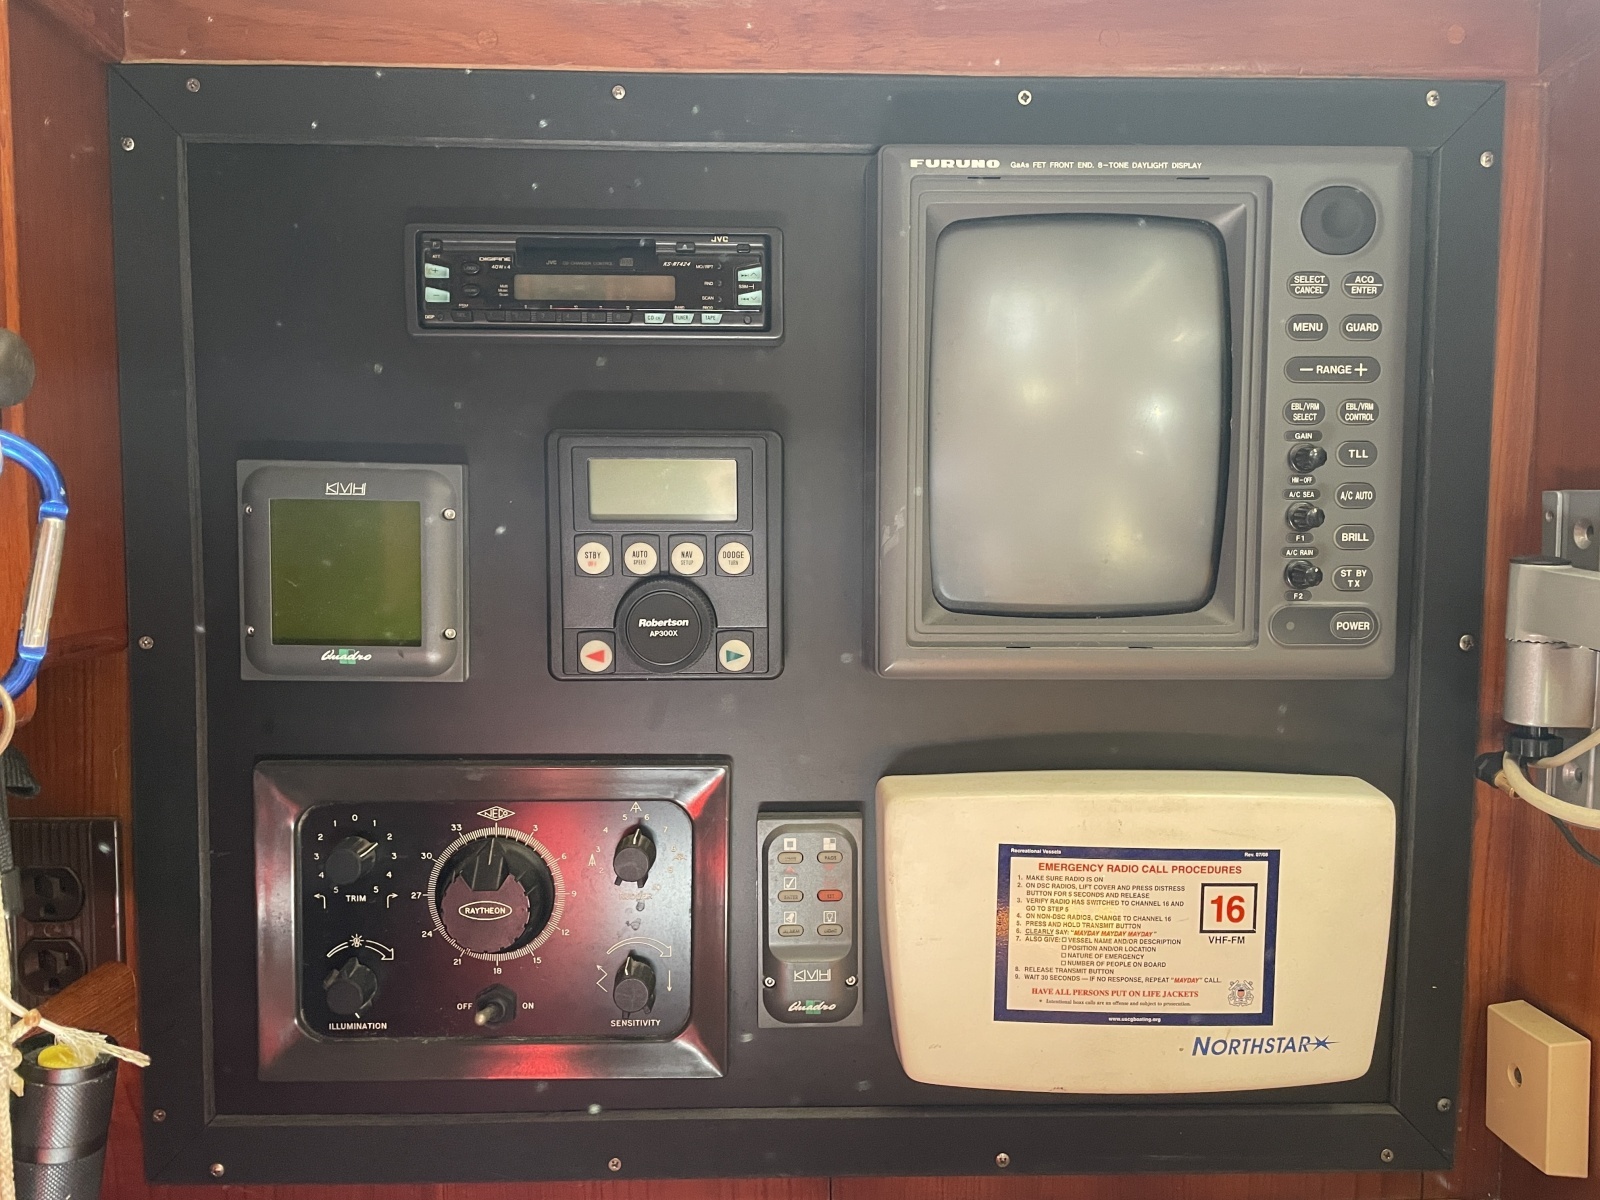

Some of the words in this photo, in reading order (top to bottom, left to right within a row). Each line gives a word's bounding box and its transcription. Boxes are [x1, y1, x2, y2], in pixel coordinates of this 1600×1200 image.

[910, 159, 1000, 168] FURUNO
[1132, 162, 1168, 170] DAYLIGHT
[1294, 275, 1325, 284] SELECT
[1354, 276, 1375, 284] ACQ
[1293, 322, 1323, 332] MENU
[1345, 323, 1379, 332] GUARD
[1316, 365, 1352, 374] RANGE
[1291, 402, 1320, 411] EBL/VRM
[1345, 402, 1374, 412] EBL/VRM
[1345, 413, 1374, 421] CONTROL
[1348, 449, 1369, 458] TLL
[325, 482, 366, 496] KVH
[1340, 491, 1353, 501] A/C
[1355, 491, 1373, 500] AUTO
[1341, 532, 1370, 542] BRILL
[638, 618, 689, 627] Robertson
[1336, 622, 1370, 631] POWER
[321, 649, 372, 661] Quadro
[420, 852, 433, 860] 30
[1038, 862, 1104, 873] EMERGENCY
[1106, 864, 1139, 873] RADIO
[1141, 865, 1168, 874] CALL
[1171, 865, 1242, 874] PROCEDURES
[345, 894, 367, 902] TRIM
[464, 906, 506, 915] RAYTHEON
[1210, 895, 1245, 923] 16
[561, 928, 570, 936] 12
[1208, 936, 1245, 944] VHF-FM
[533, 956, 542, 964] 15
[793, 968, 831, 982] KVH
[788, 1000, 837, 1012] Quadro
[328, 1022, 388, 1030] ILLUMINATION
[610, 1019, 661, 1027] SENSITIVITY
[1192, 1036, 1311, 1056] NORTHSTAR
